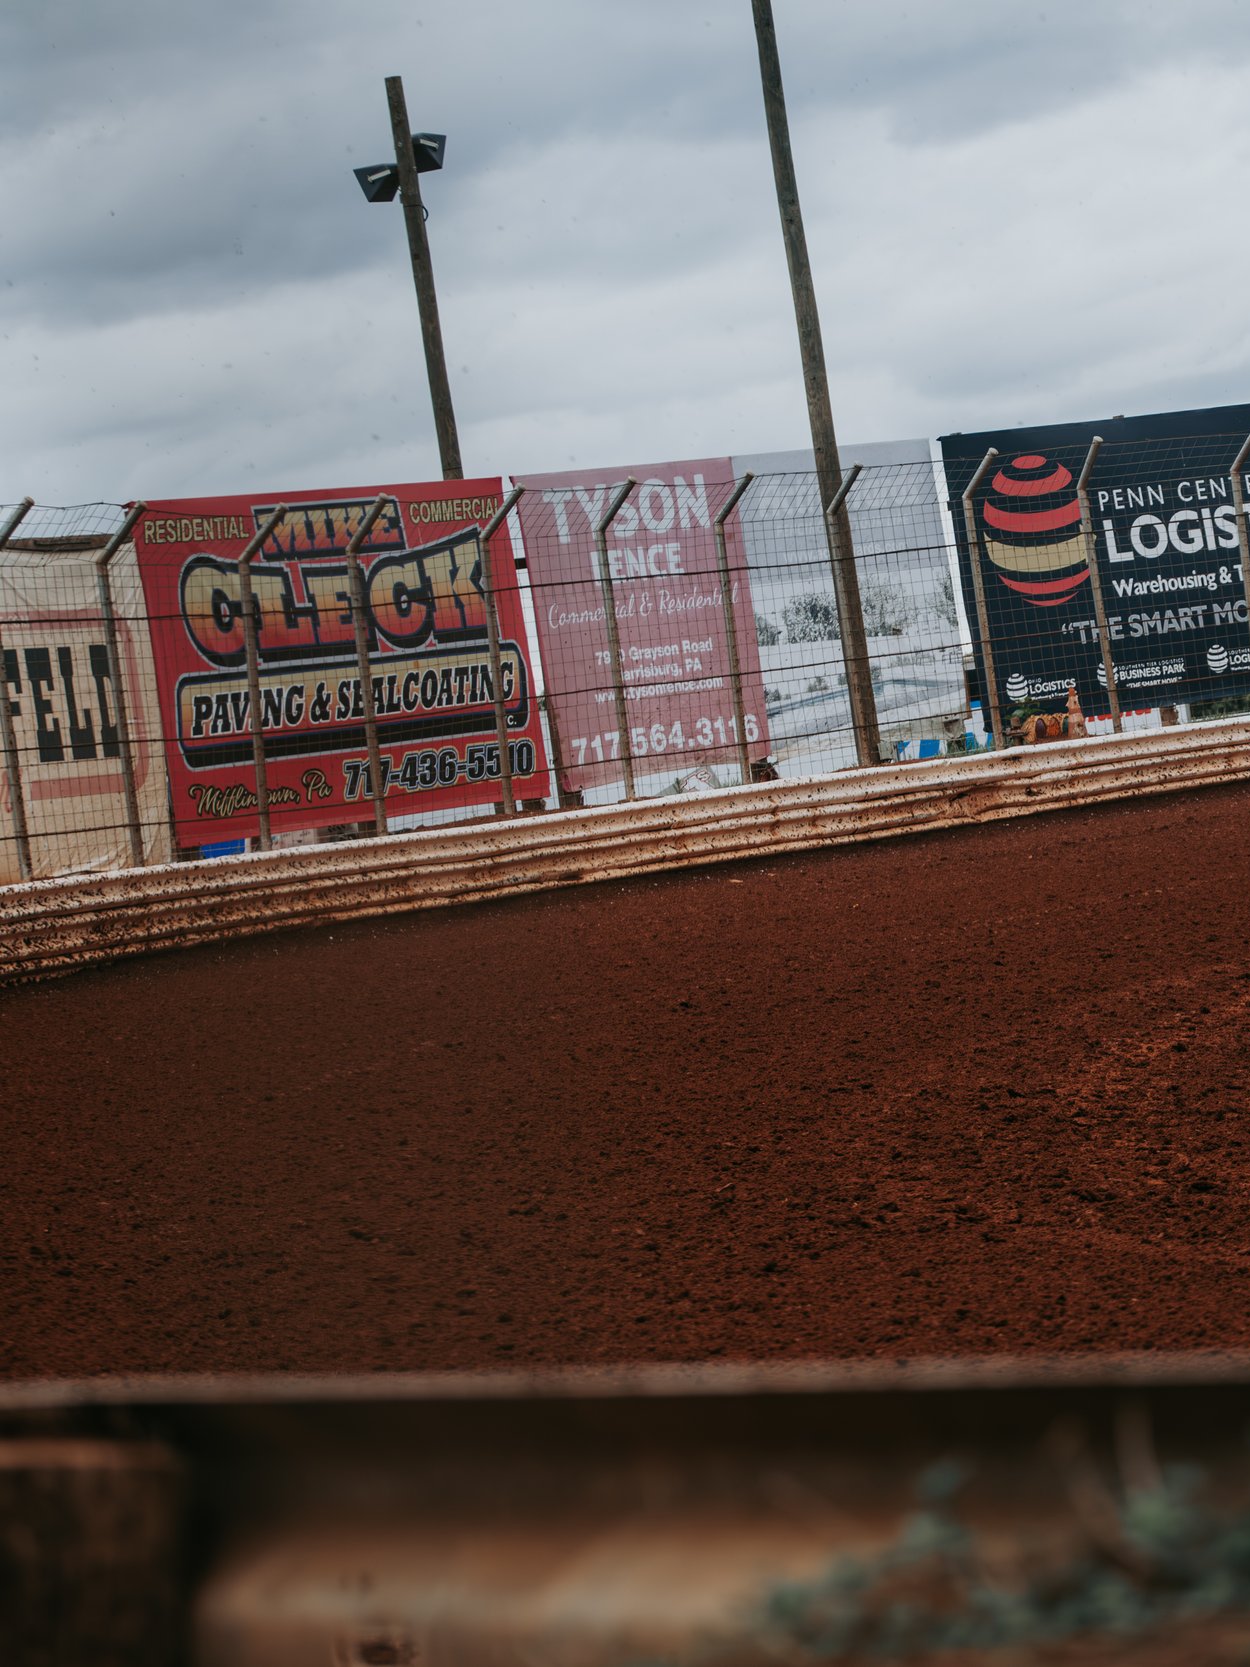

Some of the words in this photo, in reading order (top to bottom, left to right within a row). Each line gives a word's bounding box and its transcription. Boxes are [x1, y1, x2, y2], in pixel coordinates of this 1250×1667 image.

[543, 473, 711, 545] TYSON
[1097, 484, 1165, 511] PENN
[144, 516, 250, 545] RESIDENTIAL
[254, 499, 405, 560] MIKE
[1112, 570, 1217, 598] Warehousing
[1219, 565, 1233, 584] &
[549, 593, 635, 629] Commerial
[639, 591, 653, 618] &
[659, 582, 739, 615] Residentil
[1129, 605, 1208, 638] SMART
[595, 648, 625, 666] 790
[629, 644, 679, 661] Grayson
[682, 637, 713, 654] Road
[685, 657, 702, 672] PA
[1030, 677, 1077, 694] LOGISTICS
[1119, 666, 1162, 681] BUSINESS
[1162, 662, 1186, 676] PARK
[191, 684, 305, 738] PAVNG
[310, 680, 331, 724] &
[335, 661, 514, 721] SEALCOATING
[595, 677, 724, 705] ww.tysonfence.com
[571, 713, 759, 769] 717564.3116
[343, 738, 536, 801] 717-436-5510
[189, 784, 300, 817] Mifflinown,
[302, 768, 334, 803] Pa
